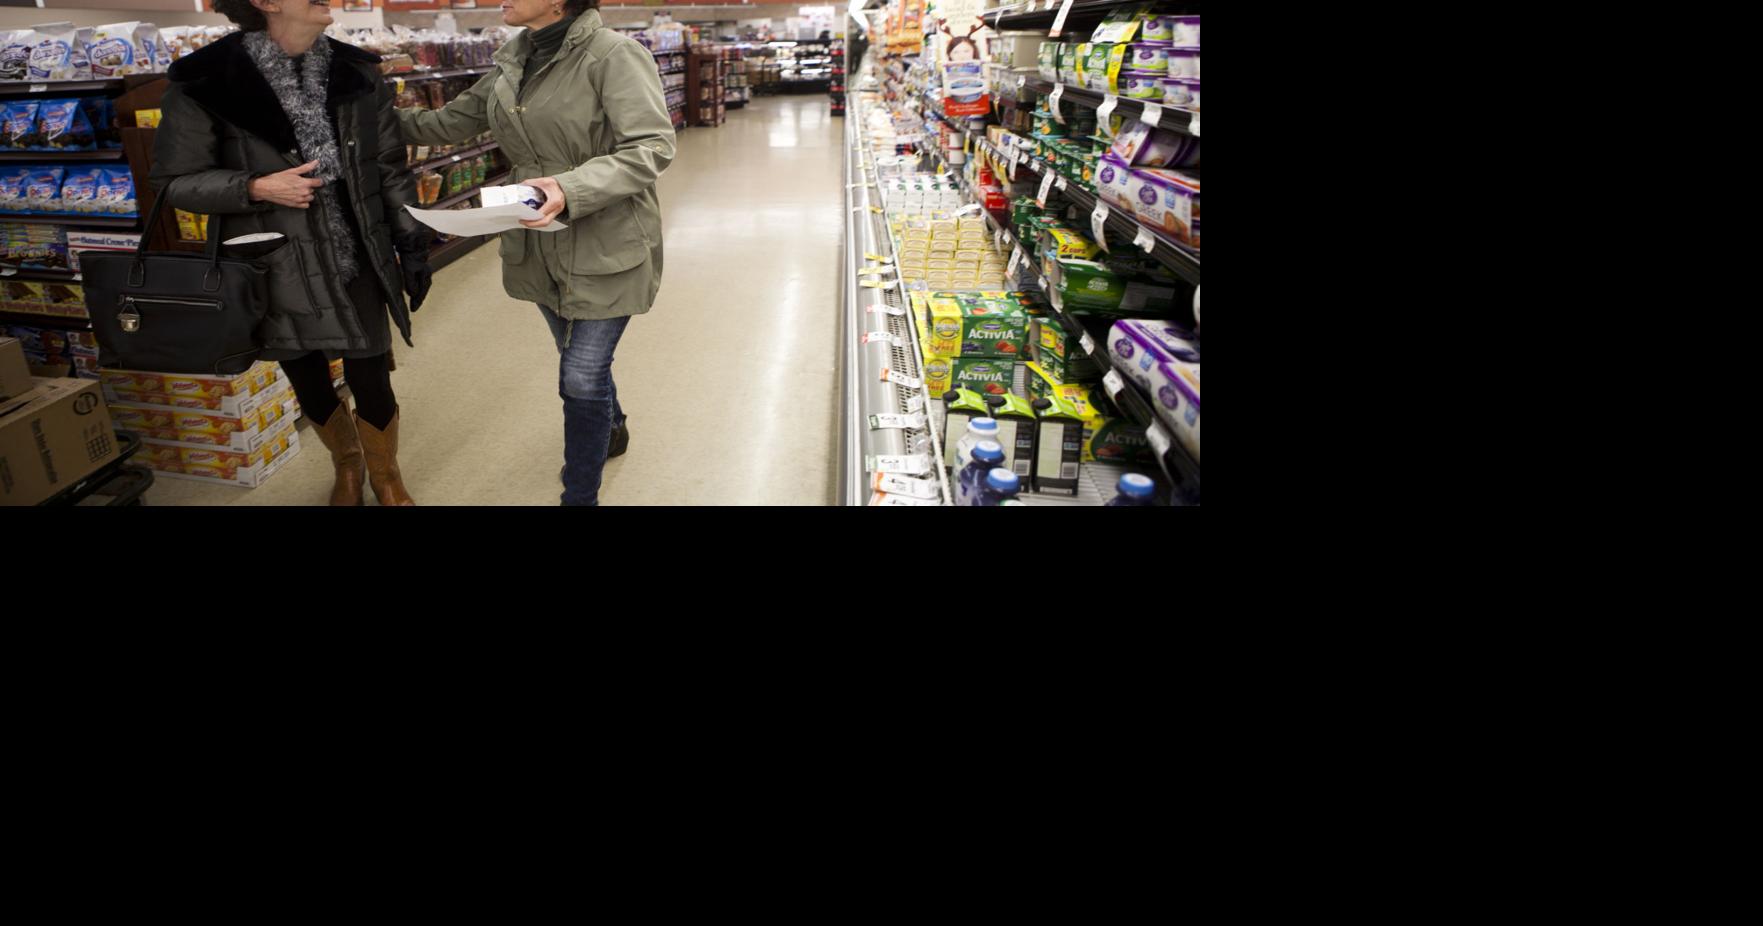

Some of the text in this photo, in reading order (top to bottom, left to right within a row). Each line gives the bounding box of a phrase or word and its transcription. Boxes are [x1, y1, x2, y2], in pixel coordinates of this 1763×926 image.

[968, 328, 1015, 340] ACTIVIA
[957, 370, 1003, 382] ACTIVIA
[1104, 431, 1147, 446] ACTIV
